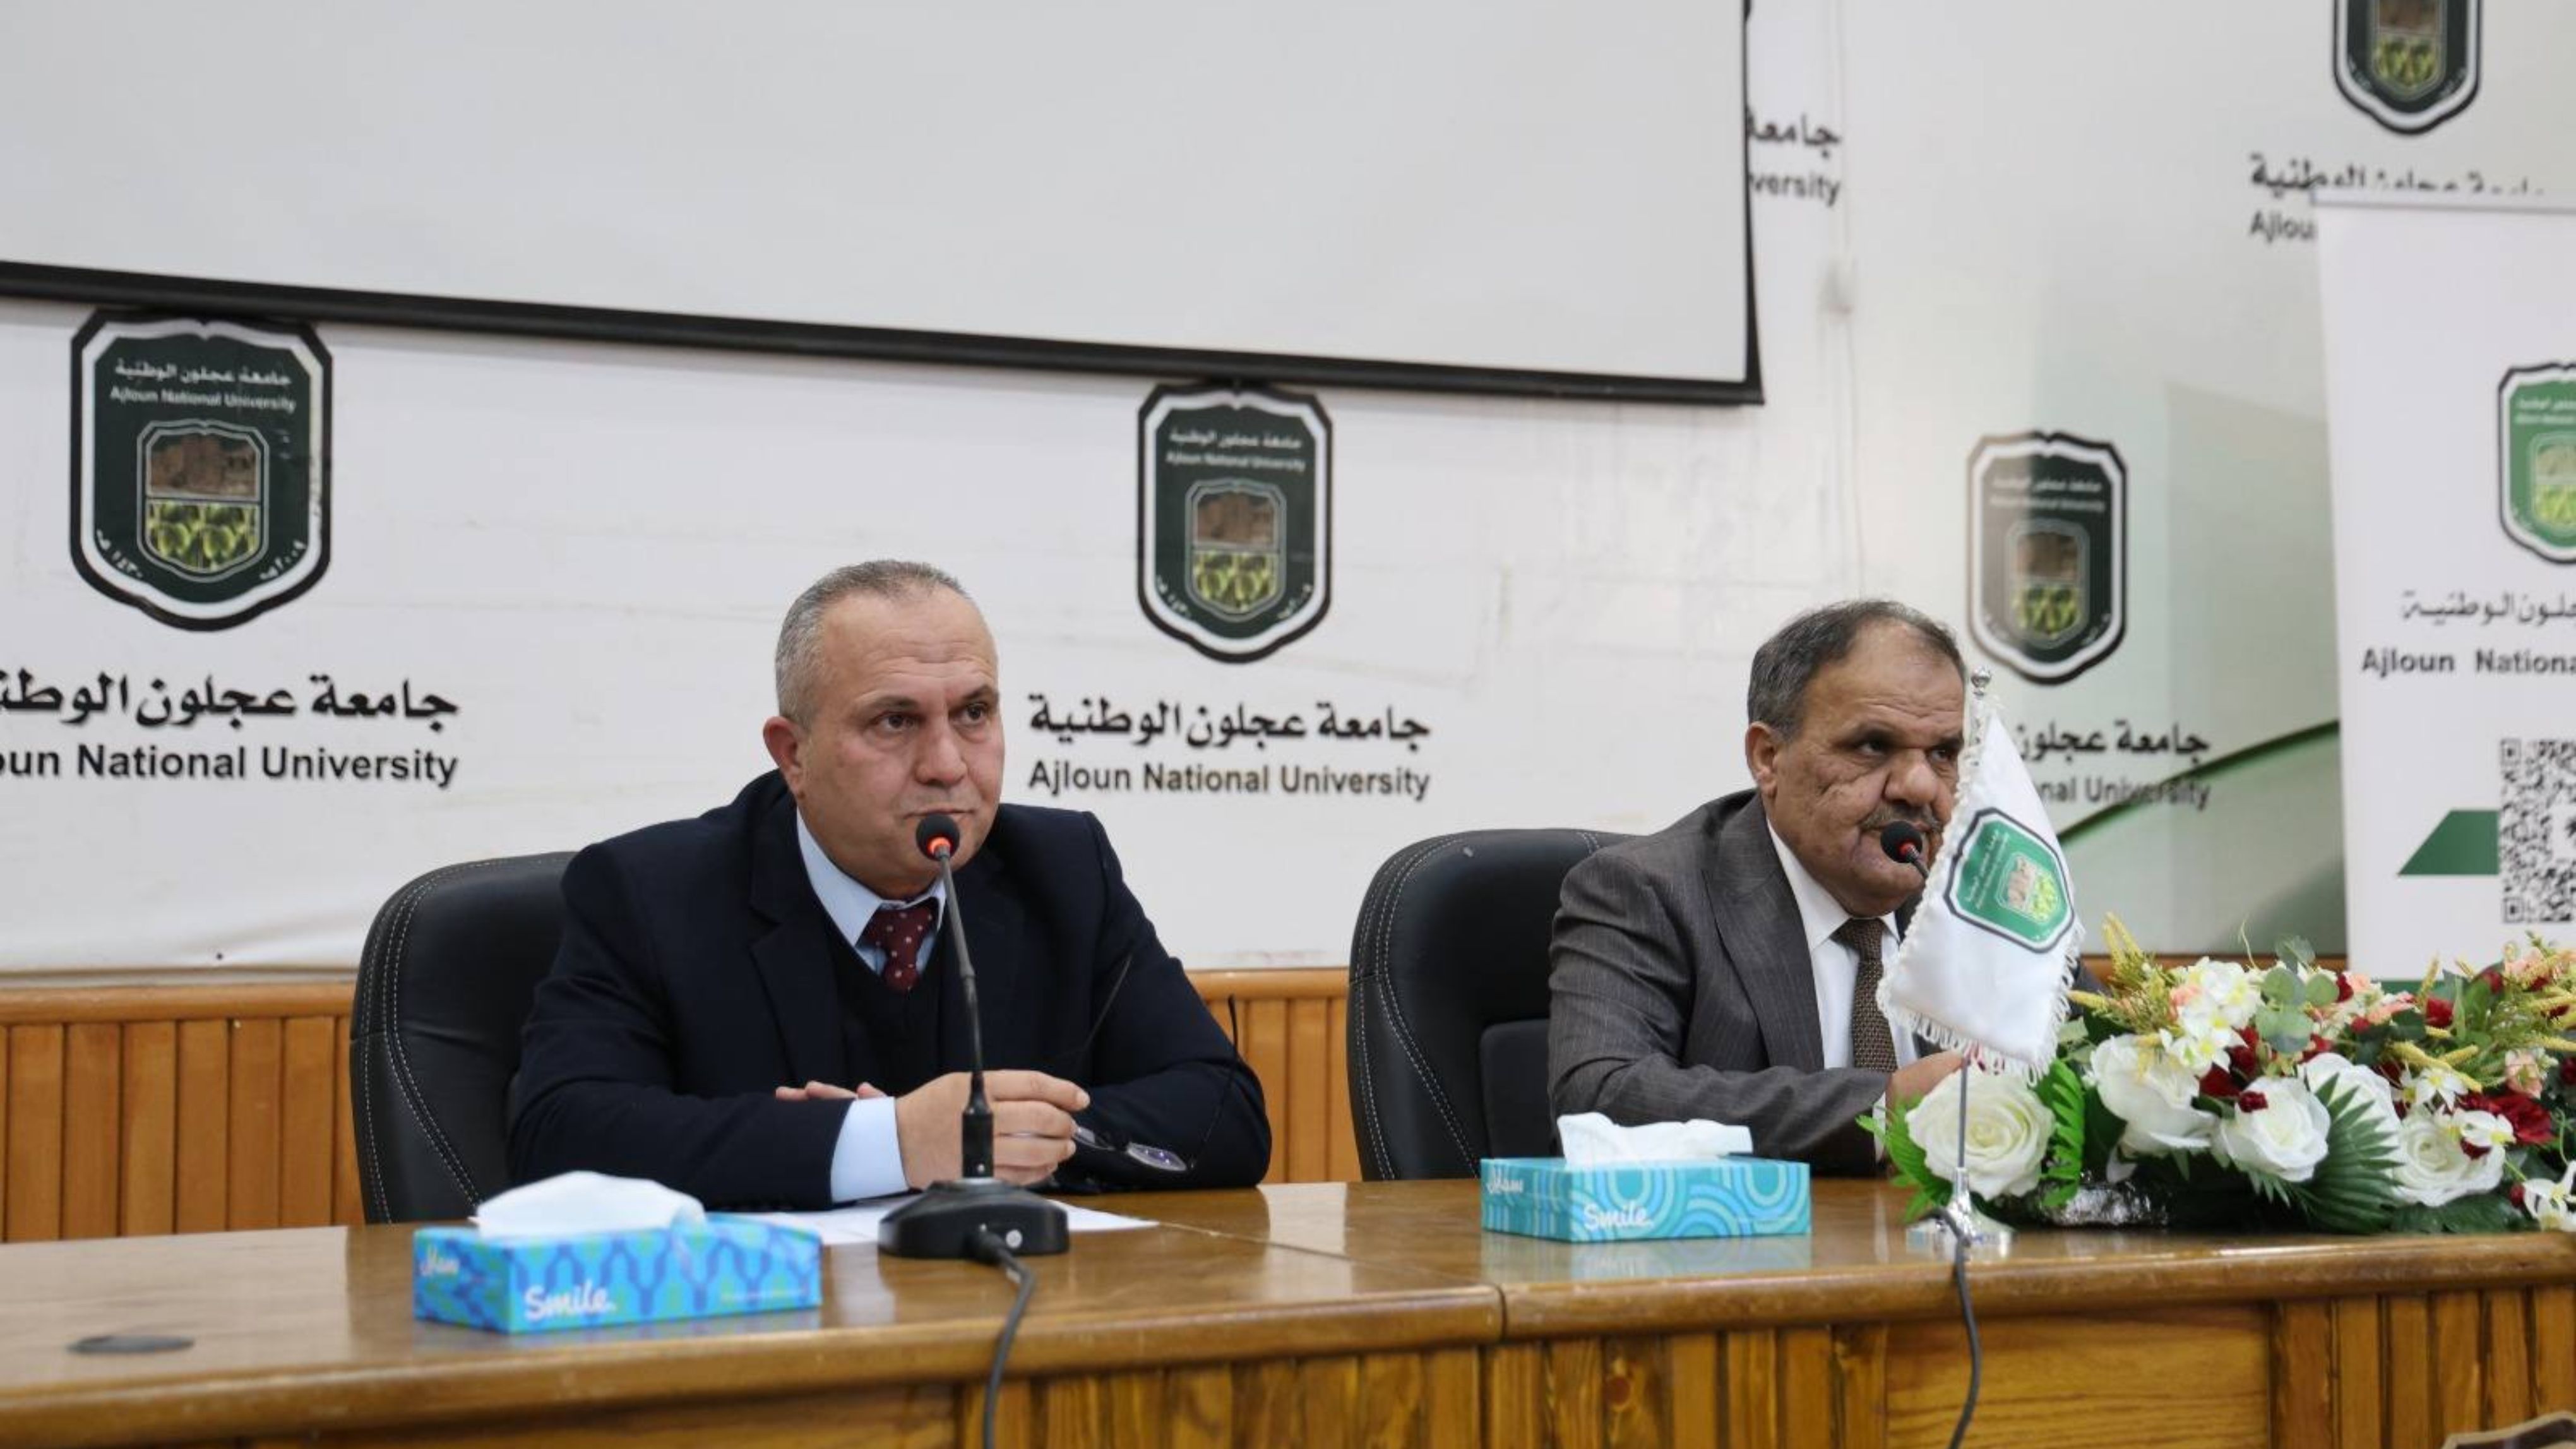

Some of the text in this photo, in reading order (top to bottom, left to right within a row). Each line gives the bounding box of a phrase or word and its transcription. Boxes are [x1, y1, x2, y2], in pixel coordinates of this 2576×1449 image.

[110, 385, 296, 414] Ajloun National University
[2362, 648, 2455, 679] Ajloun
[135, 674, 296, 729] عجلون
[309, 673, 458, 733] جامعة
[1028, 692, 1430, 753] جامعة عجلون الوطنية
[2114, 718, 2210, 765] جامعة
[77, 743, 245, 778] National
[262, 746, 458, 789] University
[1028, 760, 1431, 802] Ajloun National University
[2085, 775, 2211, 811] University
[1583, 1200, 1649, 1232] Smile
[523, 1279, 609, 1322] Smile
